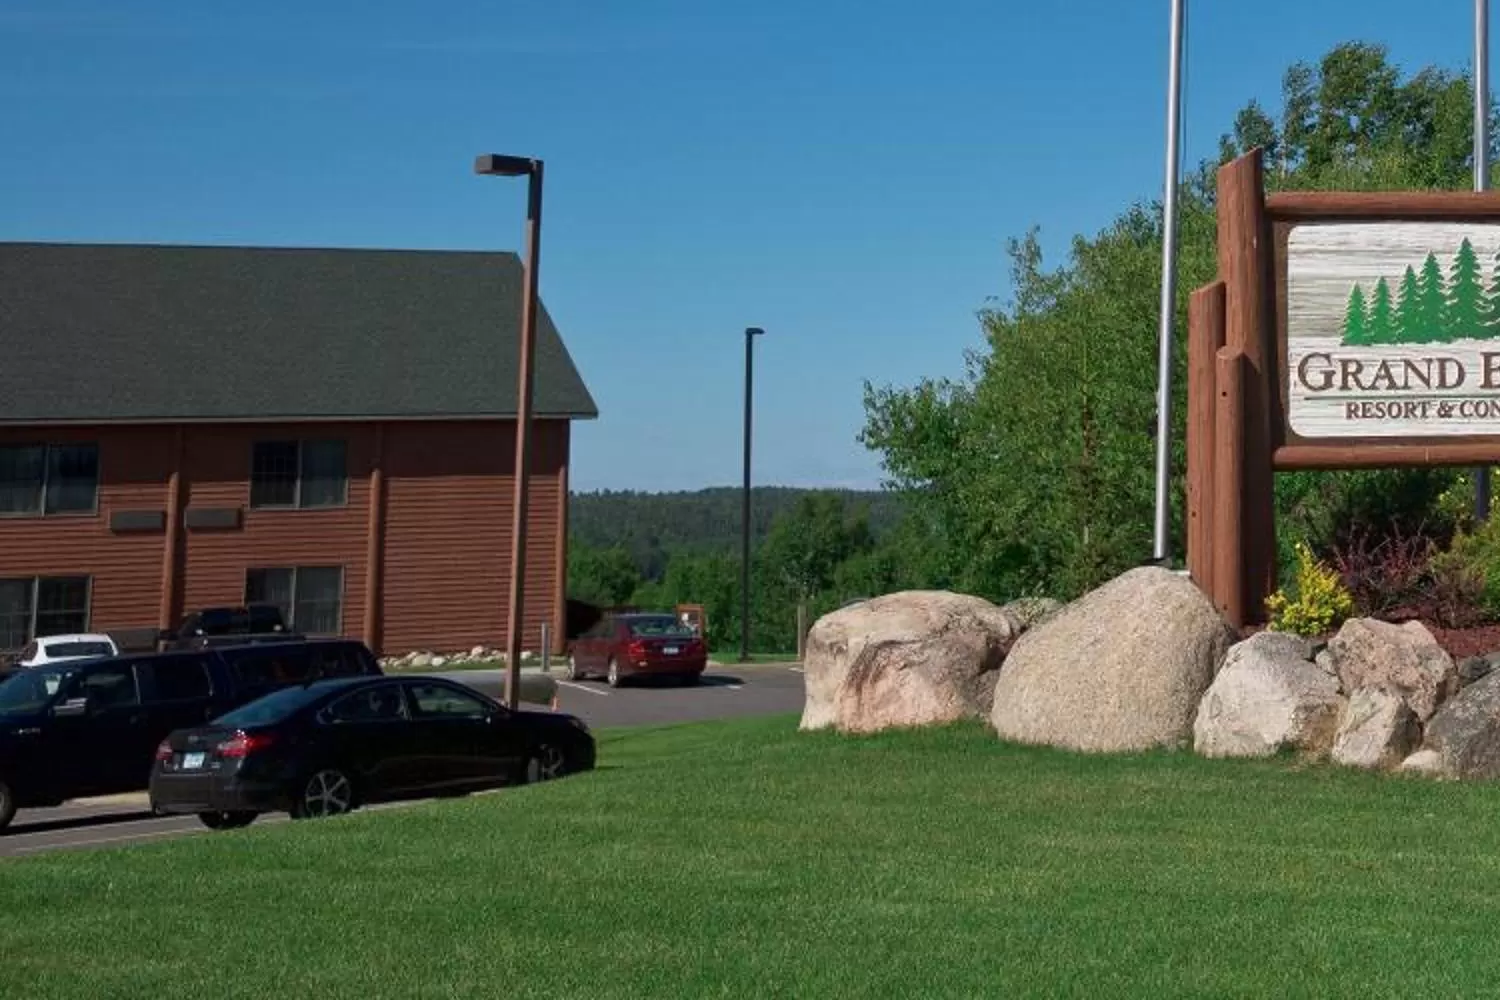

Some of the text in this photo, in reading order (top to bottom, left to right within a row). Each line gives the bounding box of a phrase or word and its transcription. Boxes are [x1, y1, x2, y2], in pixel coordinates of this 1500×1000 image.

[1297, 352, 1466, 391] GRAND
[1345, 400, 1431, 419] RESORT
[1436, 400, 1455, 418] &
